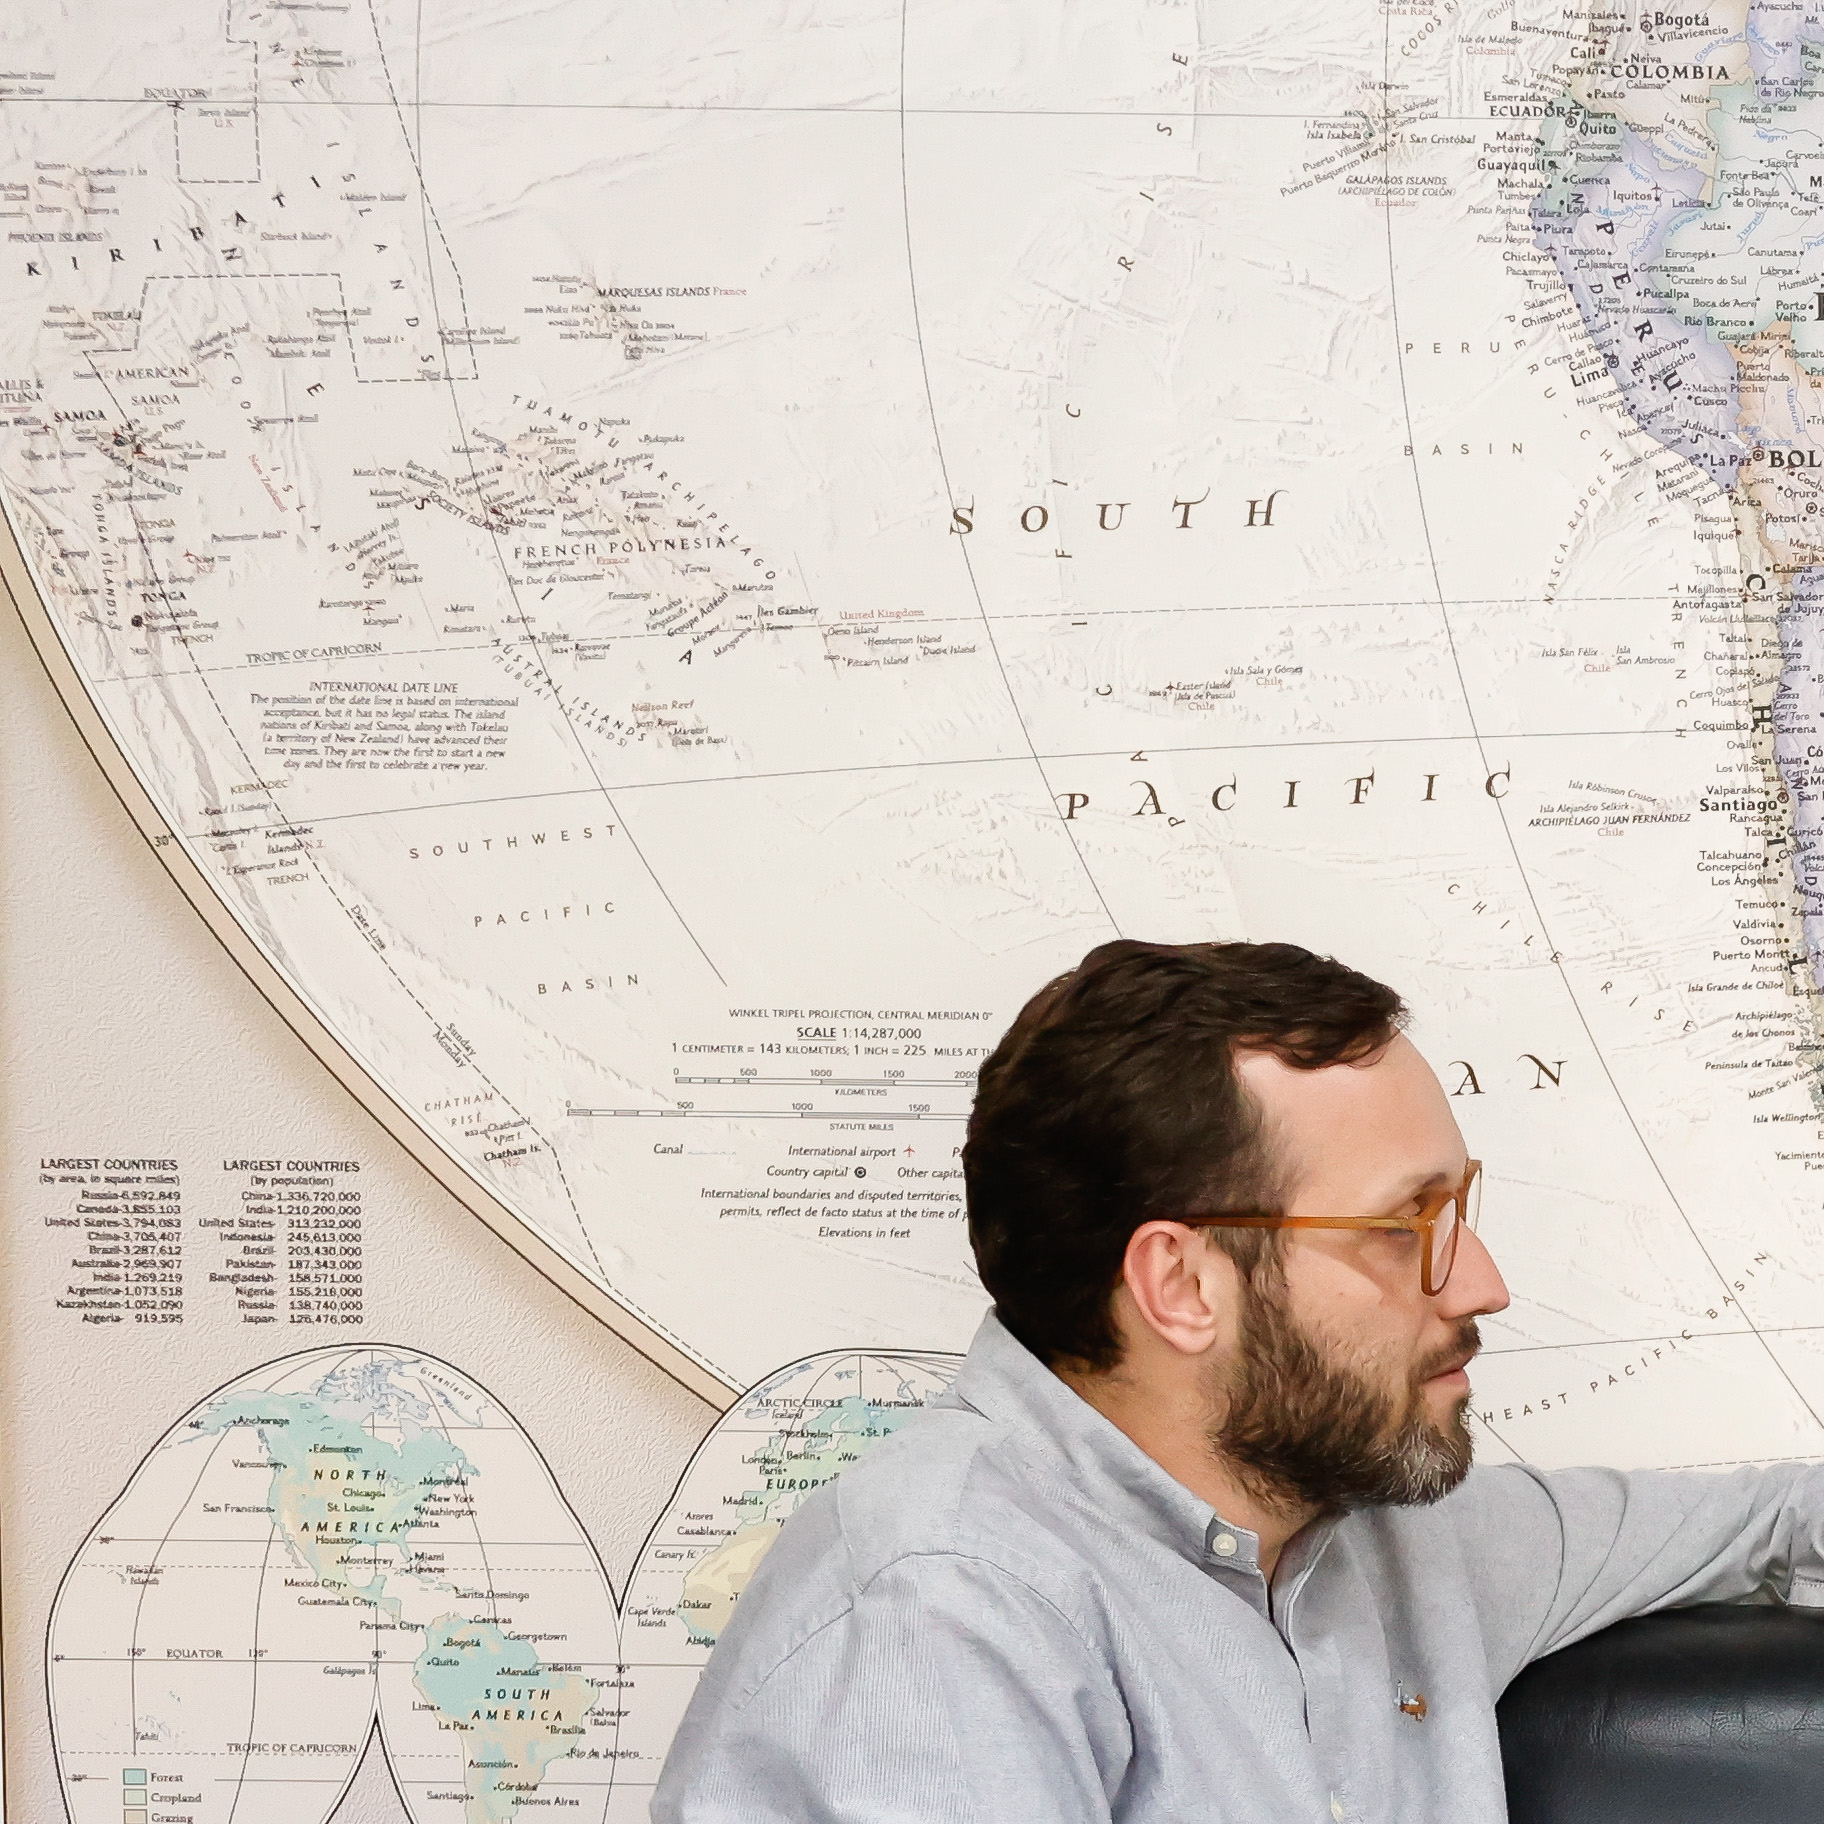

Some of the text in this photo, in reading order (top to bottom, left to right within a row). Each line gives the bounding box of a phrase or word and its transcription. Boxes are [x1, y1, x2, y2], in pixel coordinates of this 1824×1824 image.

[1655, 12, 1709, 28] Bogotá
[1609, 64, 1729, 81] COLOMBIA
[1490, 105, 1565, 118] ECUADOR
[1580, 122, 1617, 136] Quito
[1478, 157, 1545, 174] Guayaquil
[1405, 342, 1500, 353] PERU
[1403, 444, 1524, 455] BASIN
[949, 489, 1289, 536] SOUTH
[402, 682, 430, 693] DATE
[434, 683, 458, 693] LINE
[1060, 762, 1514, 820] PACIFIC
[1700, 797, 1777, 814] Santiago
[410, 825, 617, 859] SOUTHWEST
[474, 902, 615, 928] PACIFIC
[538, 974, 639, 994] BASIN
[729, 1009, 769, 1017] WINKEL
[772, 1009, 805, 1018] TRIPEL
[878, 1011, 924, 1019] CENTRAL
[928, 1012, 979, 1020] MERIDIAN
[797, 1027, 921, 1040] SCALE 1:14,287,000
[654, 1144, 683, 1154] Canal
[789, 1145, 896, 1160] International airport
[41, 1158, 178, 1171] LARGEST COUNTRIES
[224, 1160, 360, 1172] LARGEST COUNTRIES
[767, 1166, 848, 1179] Country capital
[701, 1188, 770, 1198] International
[773, 1188, 830, 1199] boundaries
[834, 1189, 854, 1199] and
[858, 1190, 904, 1203] disputed
[818, 1227, 911, 1238] Elevations in feet
[314, 1469, 387, 1481] NORTH
[301, 1521, 399, 1534] AMERICA
[485, 1689, 550, 1699] SOUTH
[472, 1710, 562, 1721] AMERICA
[151, 1773, 183, 1782] Forest
